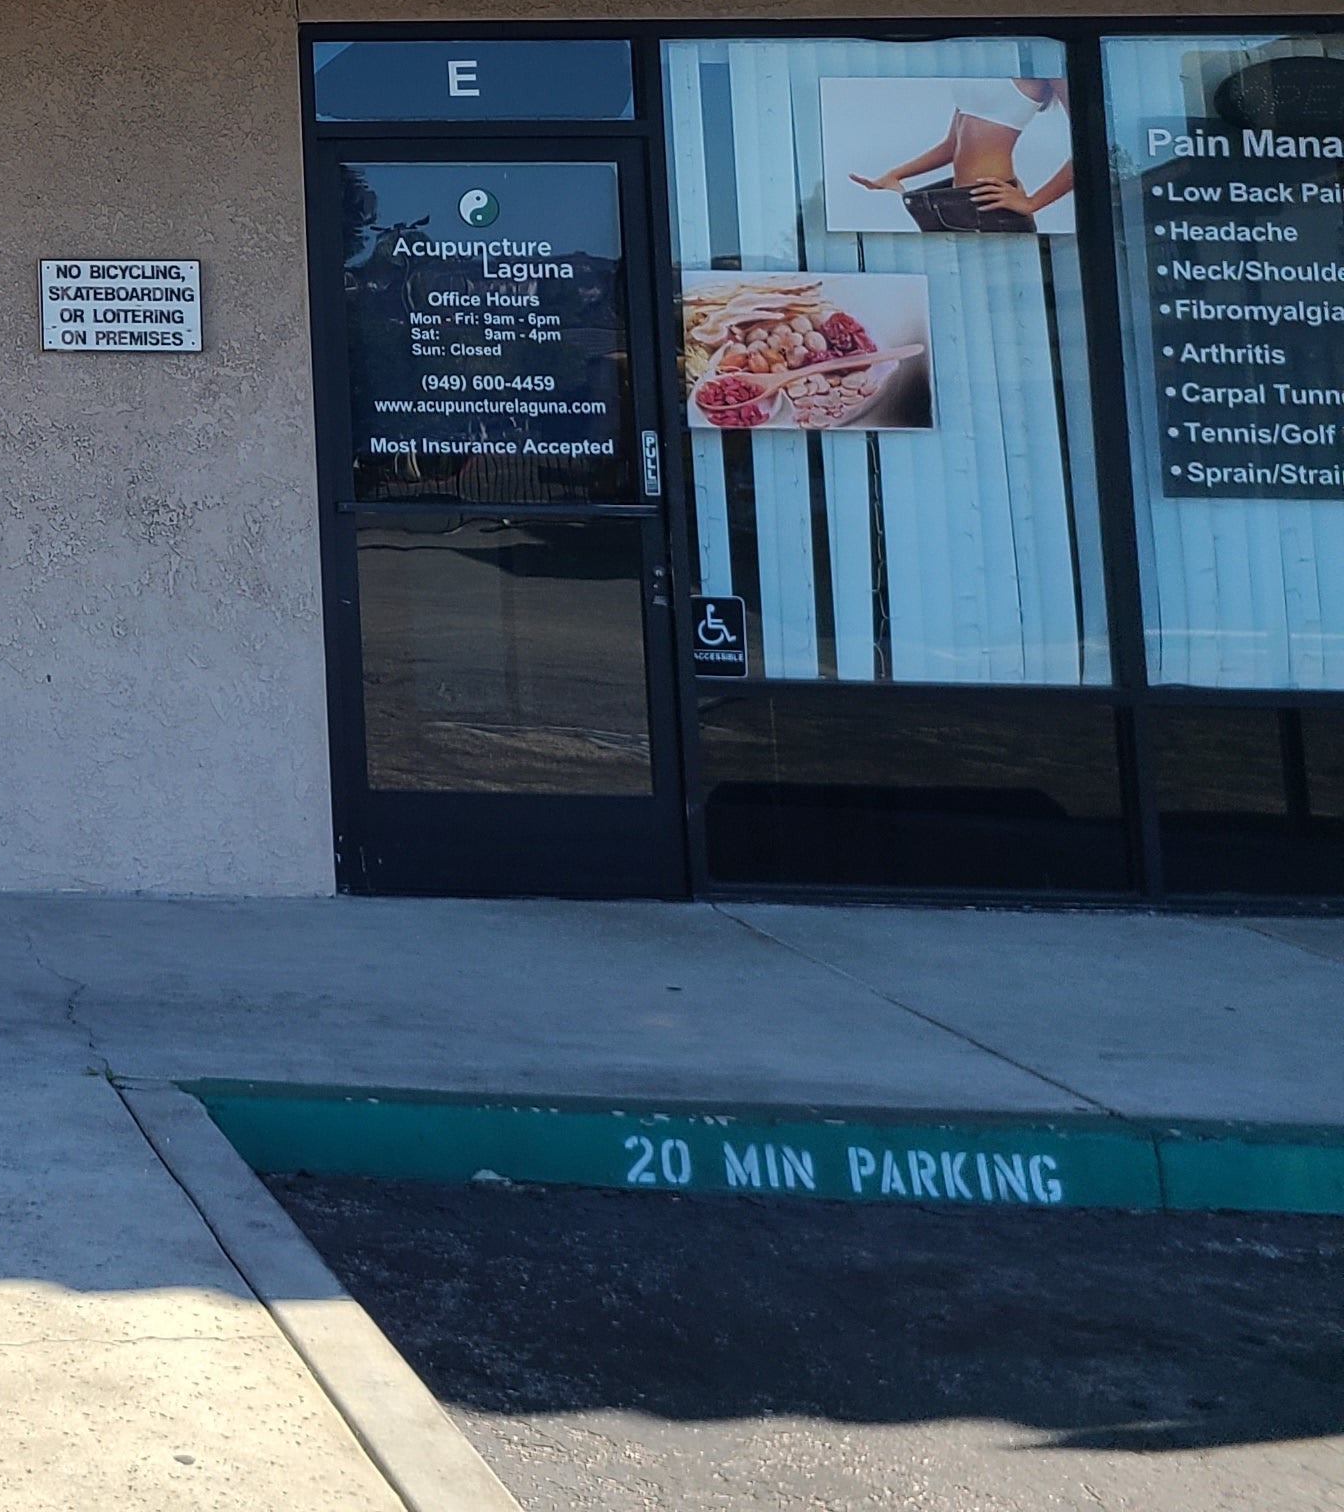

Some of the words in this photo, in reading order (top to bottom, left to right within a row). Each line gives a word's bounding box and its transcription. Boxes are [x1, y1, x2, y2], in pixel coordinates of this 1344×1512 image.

[447, 60, 480, 97] E
[1147, 128, 1230, 157] Pain
[1242, 129, 1344, 159] Mana
[1167, 182, 1221, 202] Low
[1229, 183, 1294, 203] Back
[1301, 183, 1344, 204] Pai
[1170, 221, 1298, 242] Headache
[392, 238, 552, 260] Acupuncture
[56, 264, 81, 279] NO
[89, 265, 186, 283] BICYCLING,
[483, 256, 574, 282] Laguna
[48, 286, 195, 302] SKATEBOARDING
[428, 291, 481, 307] Office
[486, 291, 540, 307] Hours
[59, 308, 85, 323] OR
[93, 309, 184, 324] LOITERING
[410, 313, 441, 325] Mon
[455, 313, 479, 325] Fri:
[483, 313, 515, 326] 9am
[527, 313, 561, 328] 6pm
[1175, 299, 1344, 326] Fibromyalgia
[61, 330, 87, 345] ON
[95, 331, 184, 346] PREMISES
[411, 328, 440, 340] Sat:
[484, 328, 516, 341] 9am
[528, 328, 561, 344] 4pm
[411, 343, 446, 356] Sun:
[450, 343, 502, 356] Closed
[1180, 343, 1286, 365] Arthritis
[421, 374, 467, 392] (949)
[472, 375, 555, 391] 600-4459
[1181, 382, 1265, 408] Carpal
[1273, 383, 1344, 406] Tunn
[374, 397, 607, 417] www.acupuncturelaguna.com
[1184, 422, 1336, 445] Tennis/Golf
[370, 438, 417, 454] Most
[422, 438, 517, 455] Insurance
[523, 438, 614, 458] Accepted
[645, 437, 657, 480] PULL
[1186, 462, 1344, 488] Sprain/Strai
[624, 1135, 692, 1185] 20
[722, 1141, 816, 1190] MIN
[847, 1146, 1063, 1204] PARKING
